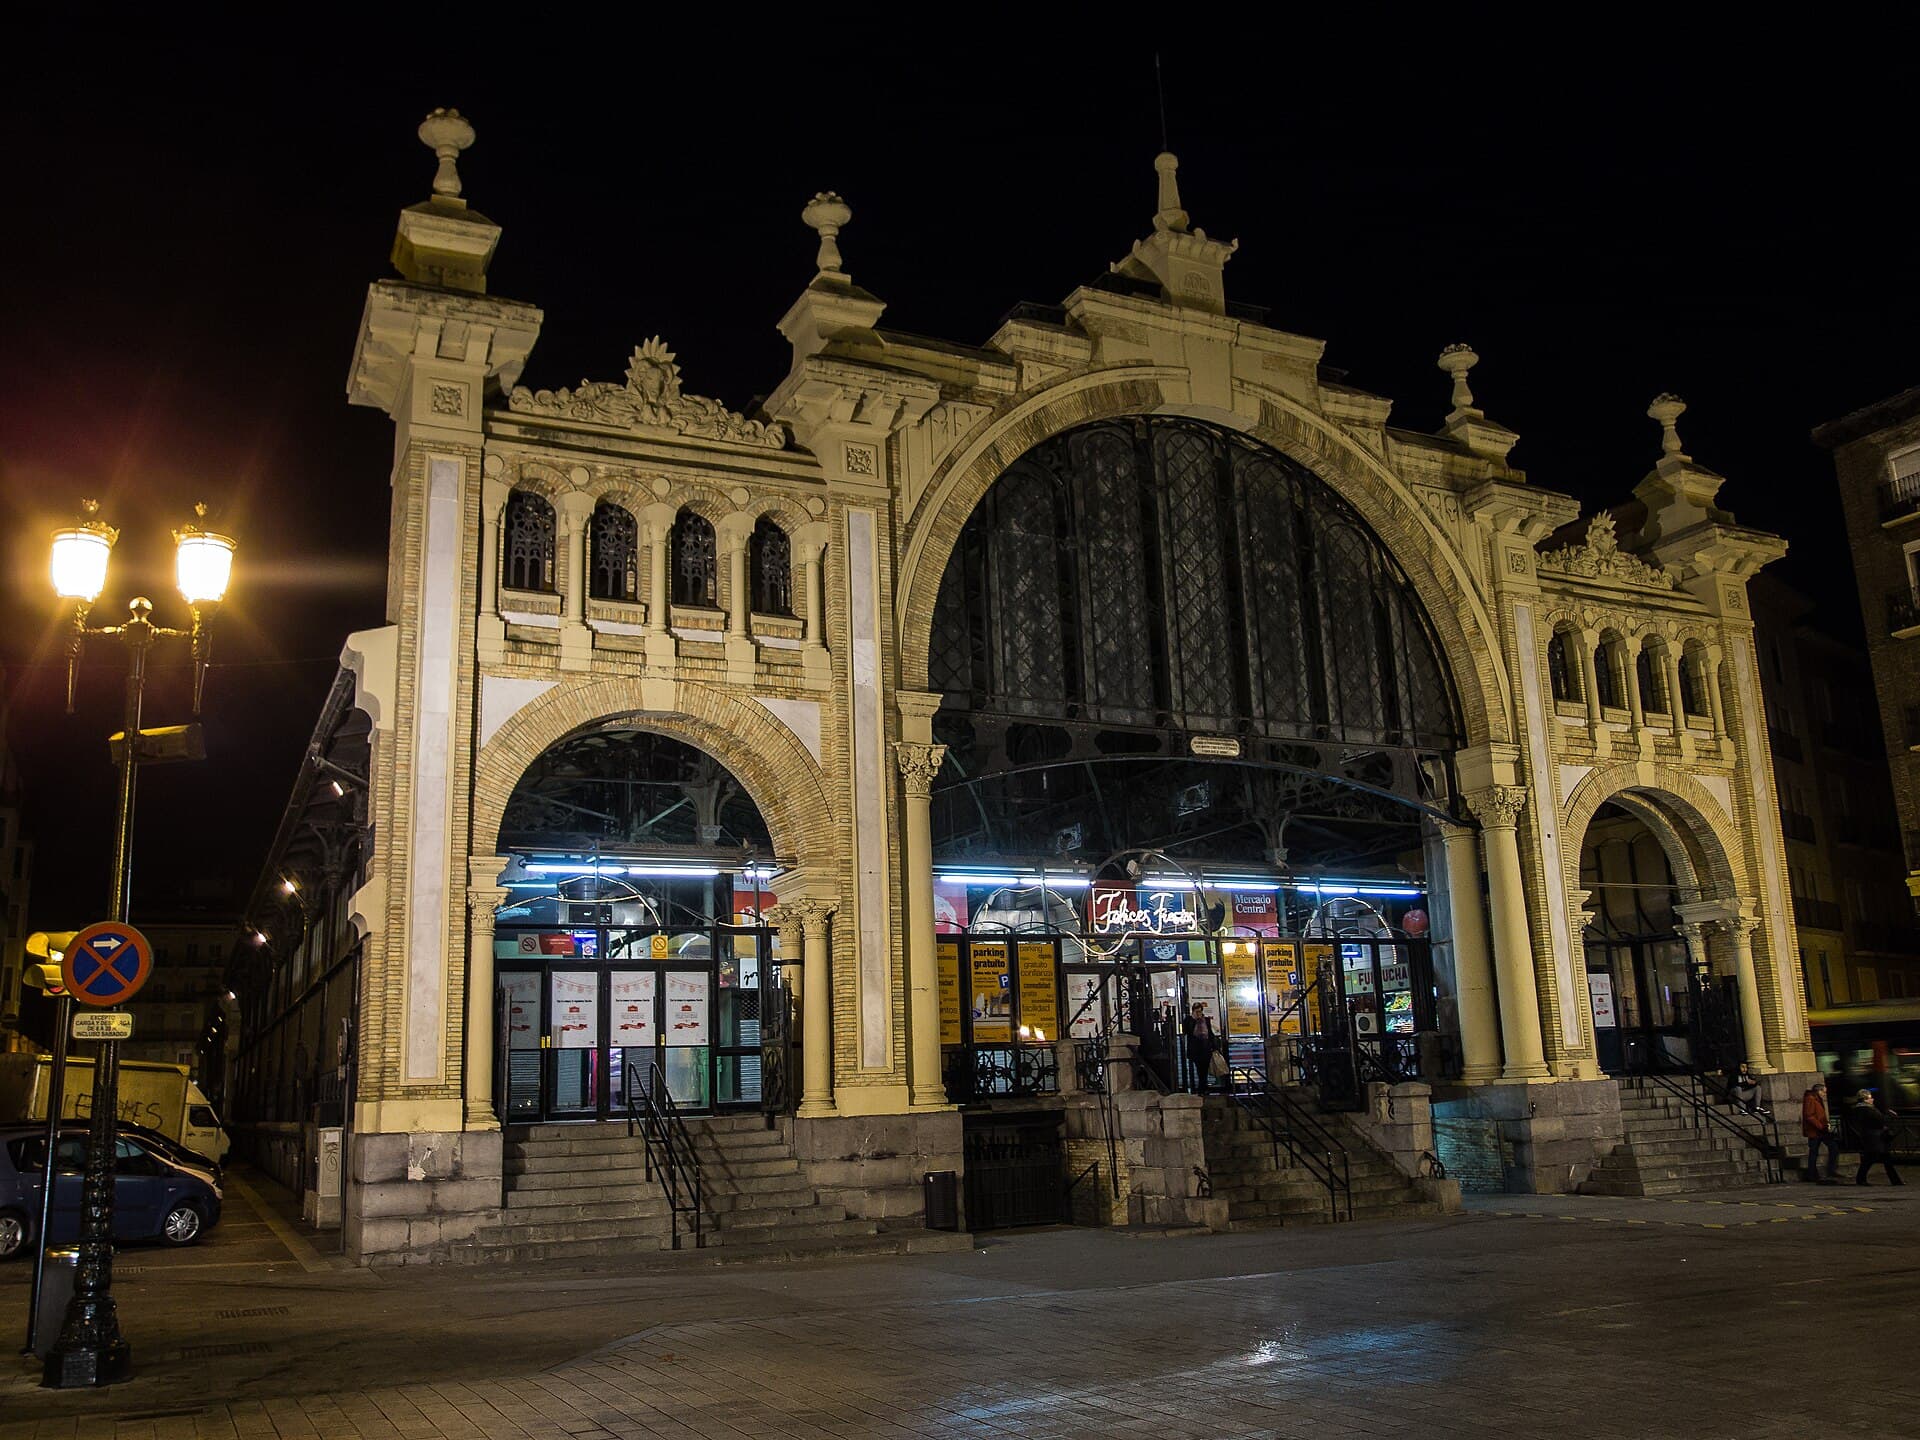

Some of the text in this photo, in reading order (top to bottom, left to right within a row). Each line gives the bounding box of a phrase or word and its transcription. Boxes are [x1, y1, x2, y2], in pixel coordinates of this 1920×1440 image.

[1234, 894, 1271, 904] Mercado
[1095, 890, 1197, 934] Felices Fiestas
[1235, 903, 1267, 914] Central
[973, 947, 1005, 959] parking
[1266, 947, 1293, 958] parking
[974, 958, 1005, 969] gratuito
[1267, 958, 1294, 968] gratuito
[1289, 973, 1297, 984] P
